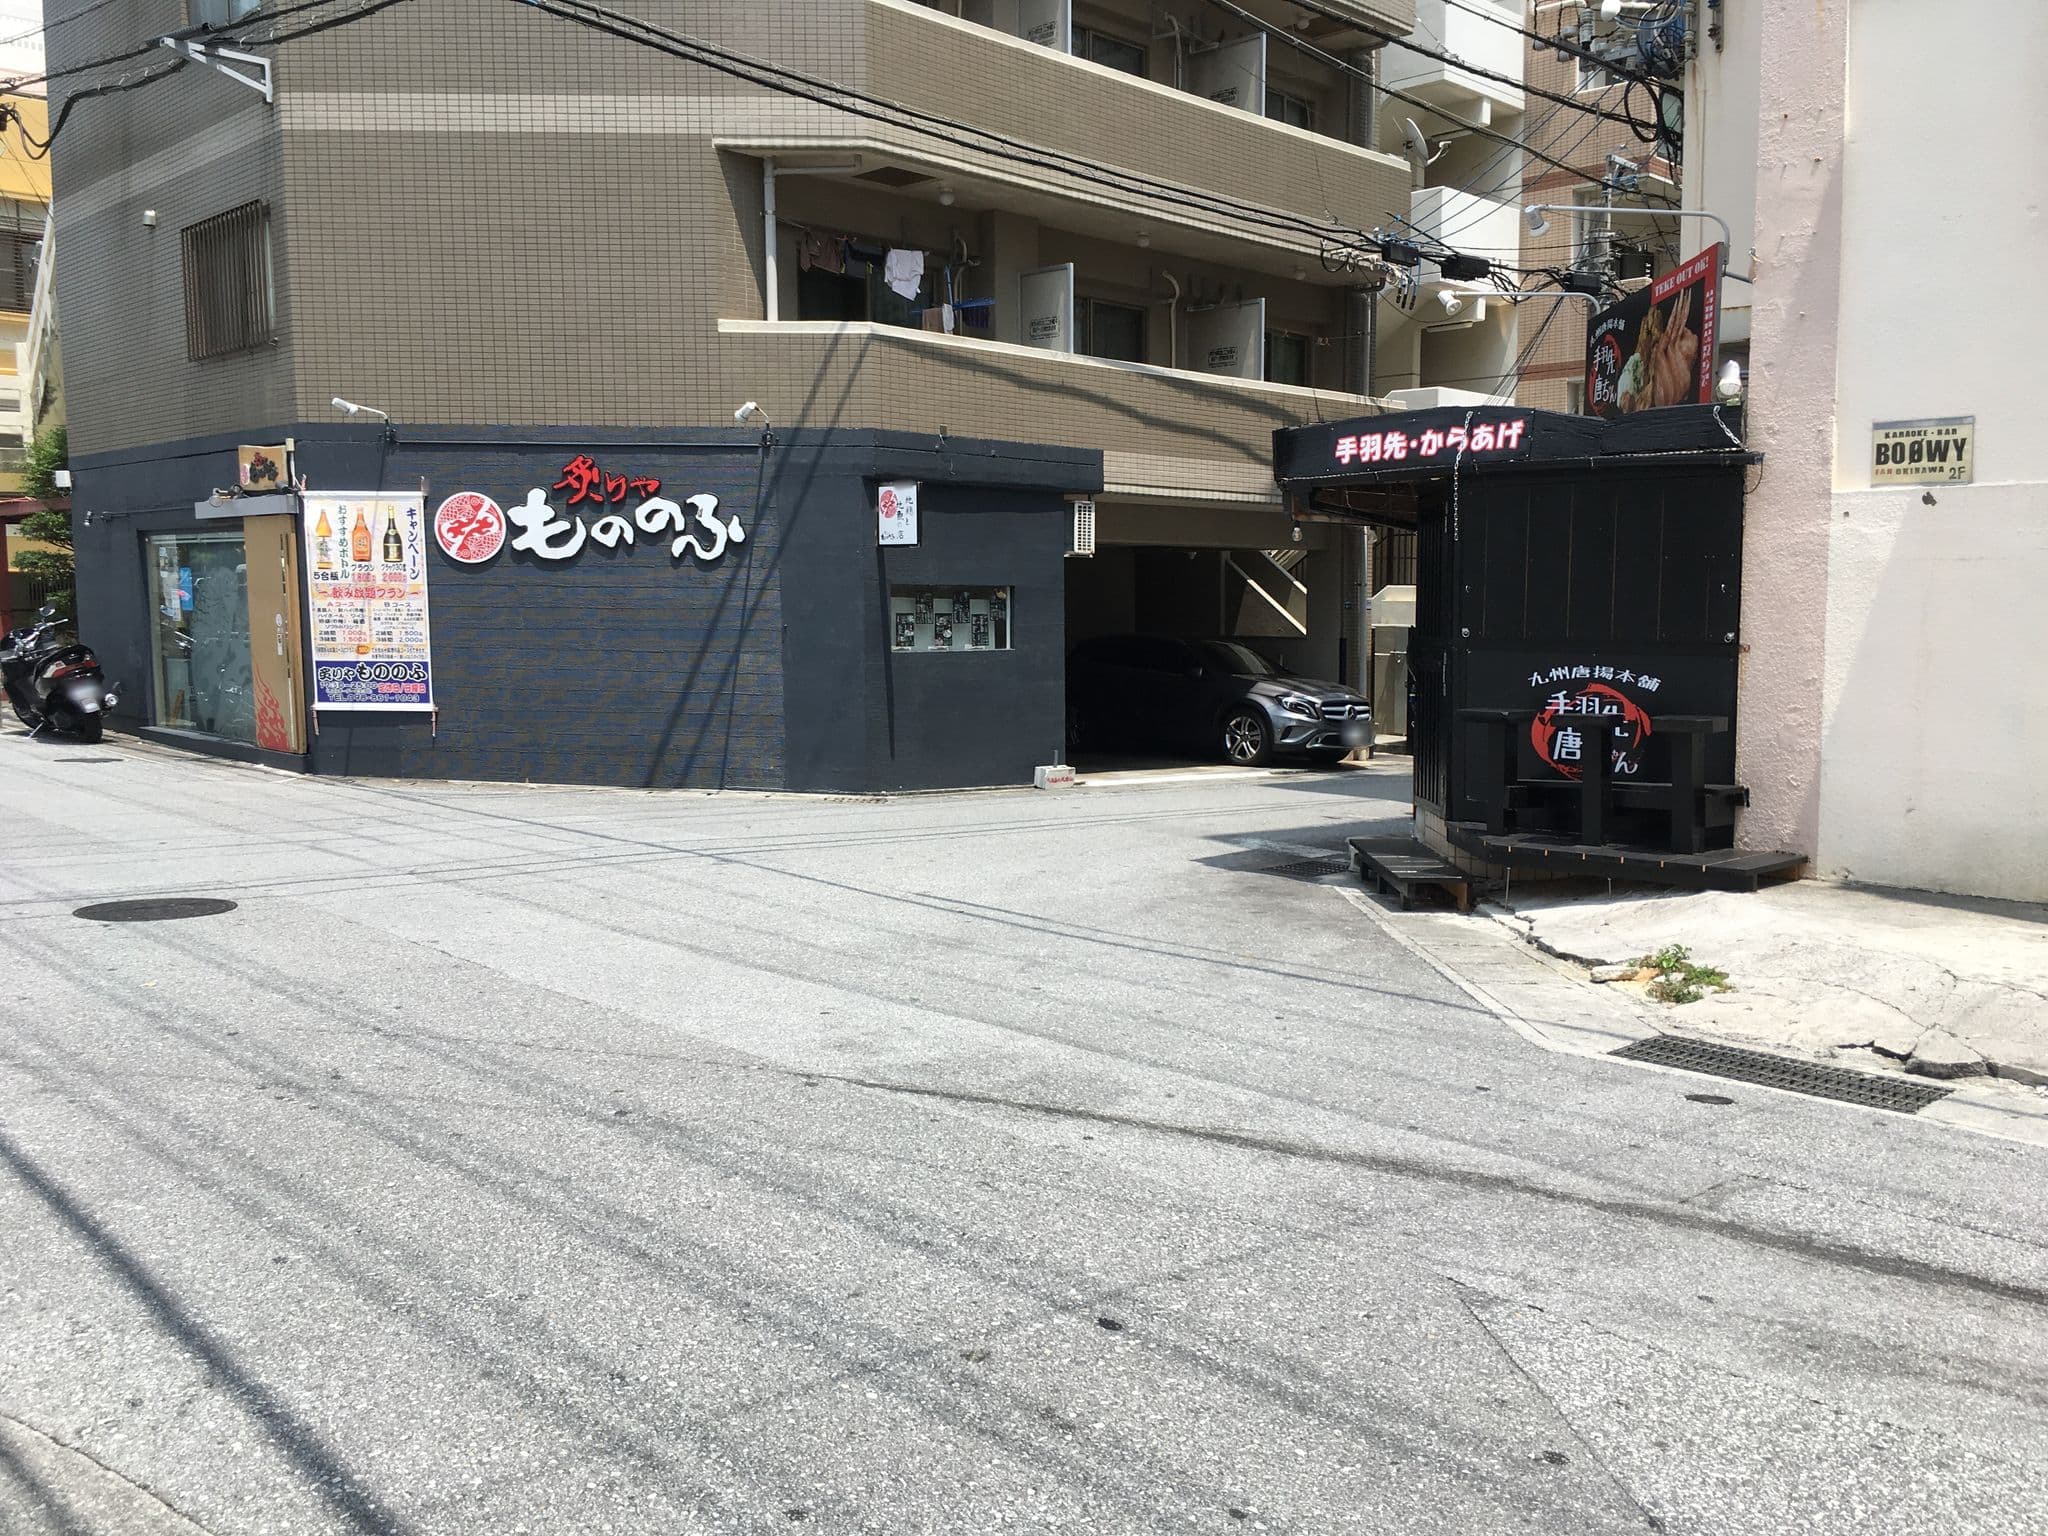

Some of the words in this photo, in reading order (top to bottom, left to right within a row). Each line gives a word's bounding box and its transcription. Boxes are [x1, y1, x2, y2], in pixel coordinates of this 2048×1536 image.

[1676, 266, 1694, 285] OUT
[1593, 345, 1616, 375] 手羽先
[1334, 419, 1525, 465] 手羽先・からあげ
[1885, 430, 1928, 439] KARAOKE
[1875, 437, 1968, 466] BOØWY
[552, 454, 662, 505] 炙りや
[1896, 466, 1945, 475] OKINAWA
[1949, 466, 1966, 480] 2F
[507, 487, 746, 562] もののふ
[338, 504, 350, 580] おすすめボトル
[406, 507, 419, 580] キャンペーン
[1527, 665, 1662, 693] 九州唐揚本舗
